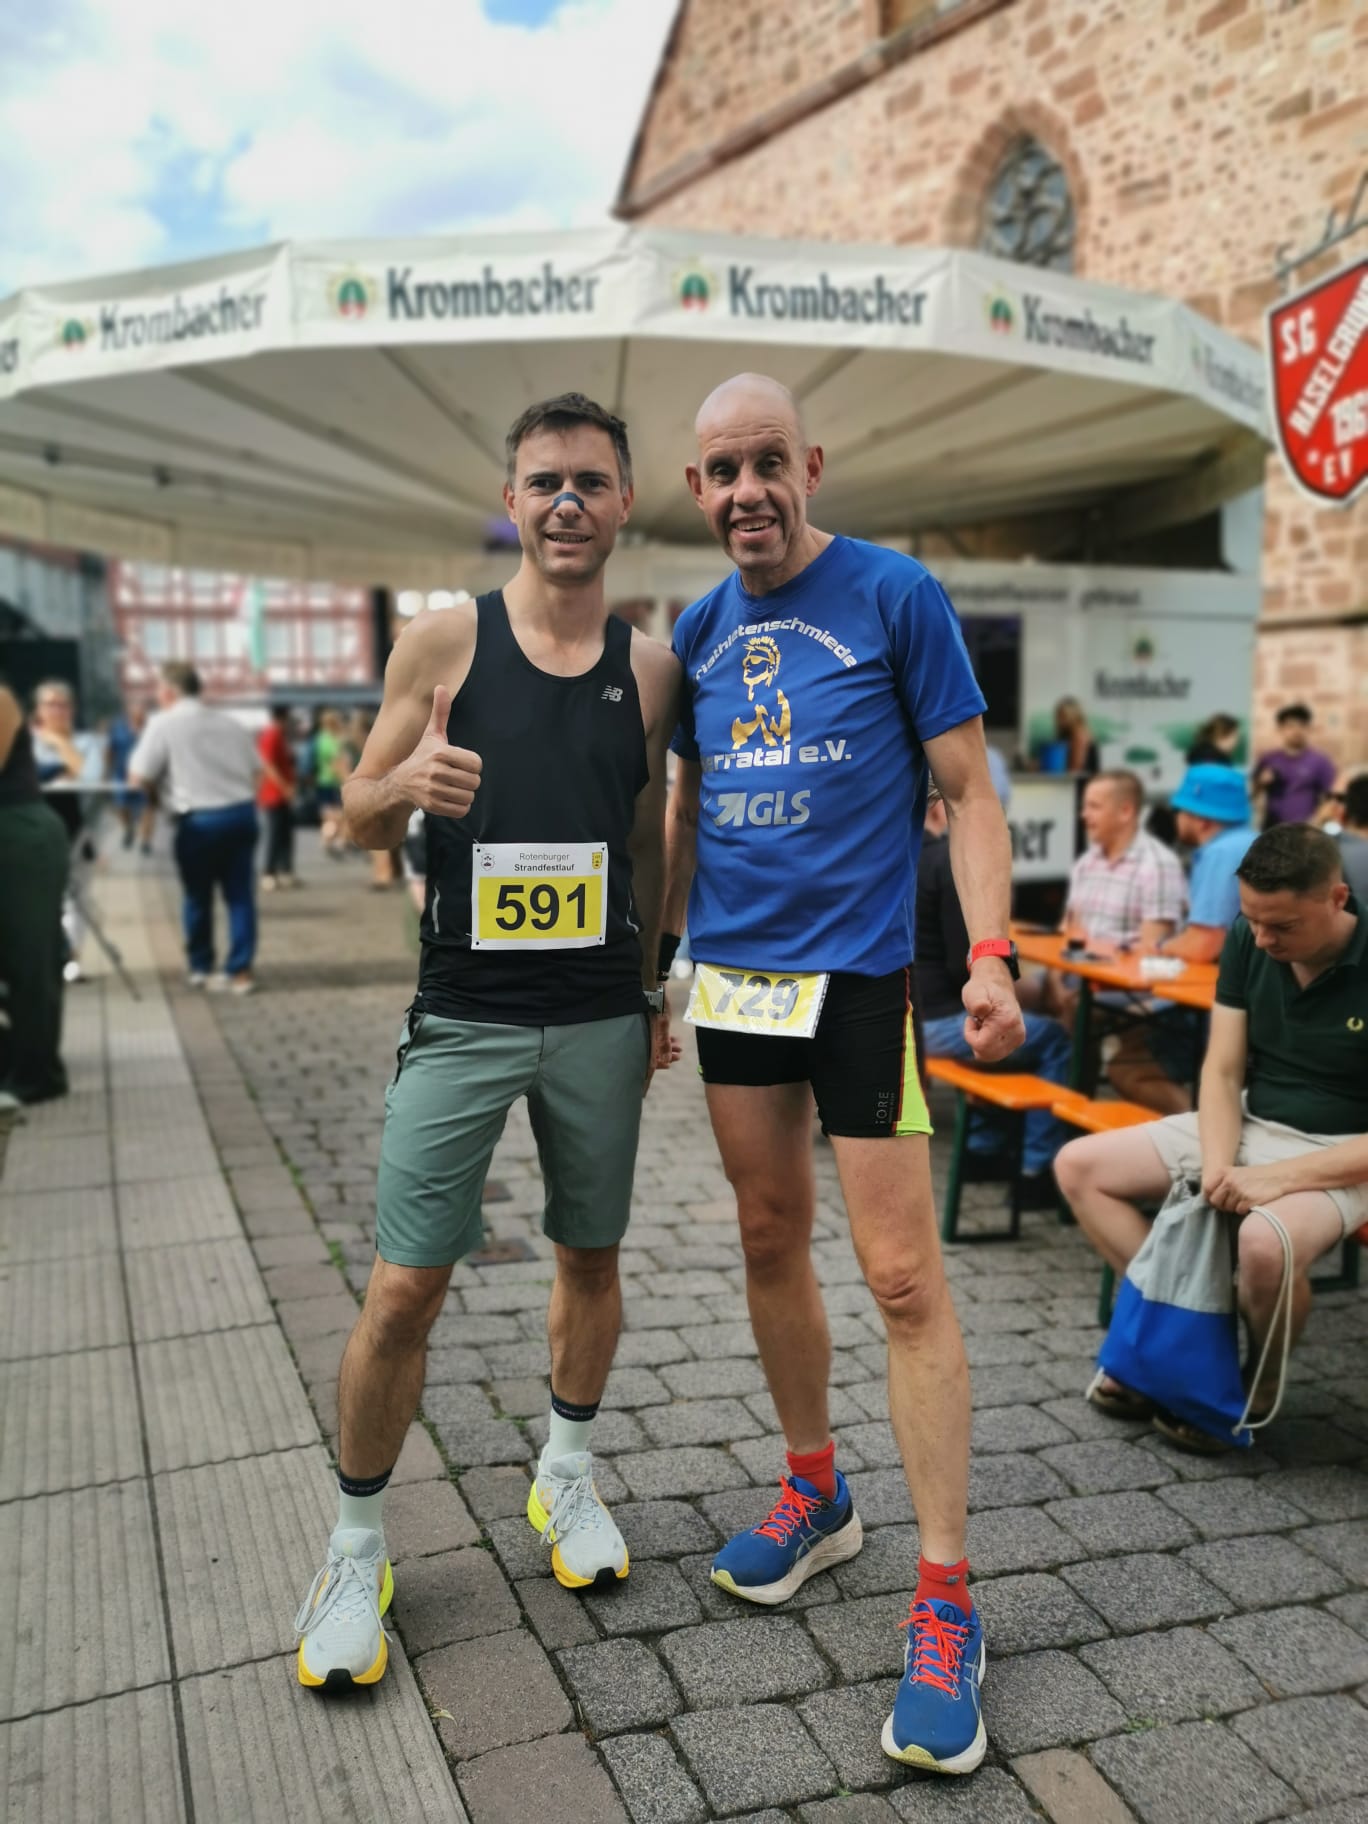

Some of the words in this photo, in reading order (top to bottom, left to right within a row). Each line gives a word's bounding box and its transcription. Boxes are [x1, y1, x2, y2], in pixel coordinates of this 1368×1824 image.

[388, 262, 600, 320] Krombacher
[729, 266, 929, 325] Krombacher
[101, 287, 267, 352] Krombacher
[1023, 294, 1156, 364] Krombacher
[1279, 307, 1317, 366] SG
[694, 616, 858, 681] riathletenschmiede
[798, 739, 852, 763] e.V.
[747, 790, 811, 826] GLS
[513, 863, 576, 873] Strandfestlauf
[519, 852, 571, 863] Rotenburger
[495, 882, 587, 932] 591
[714, 971, 801, 1021] 729
